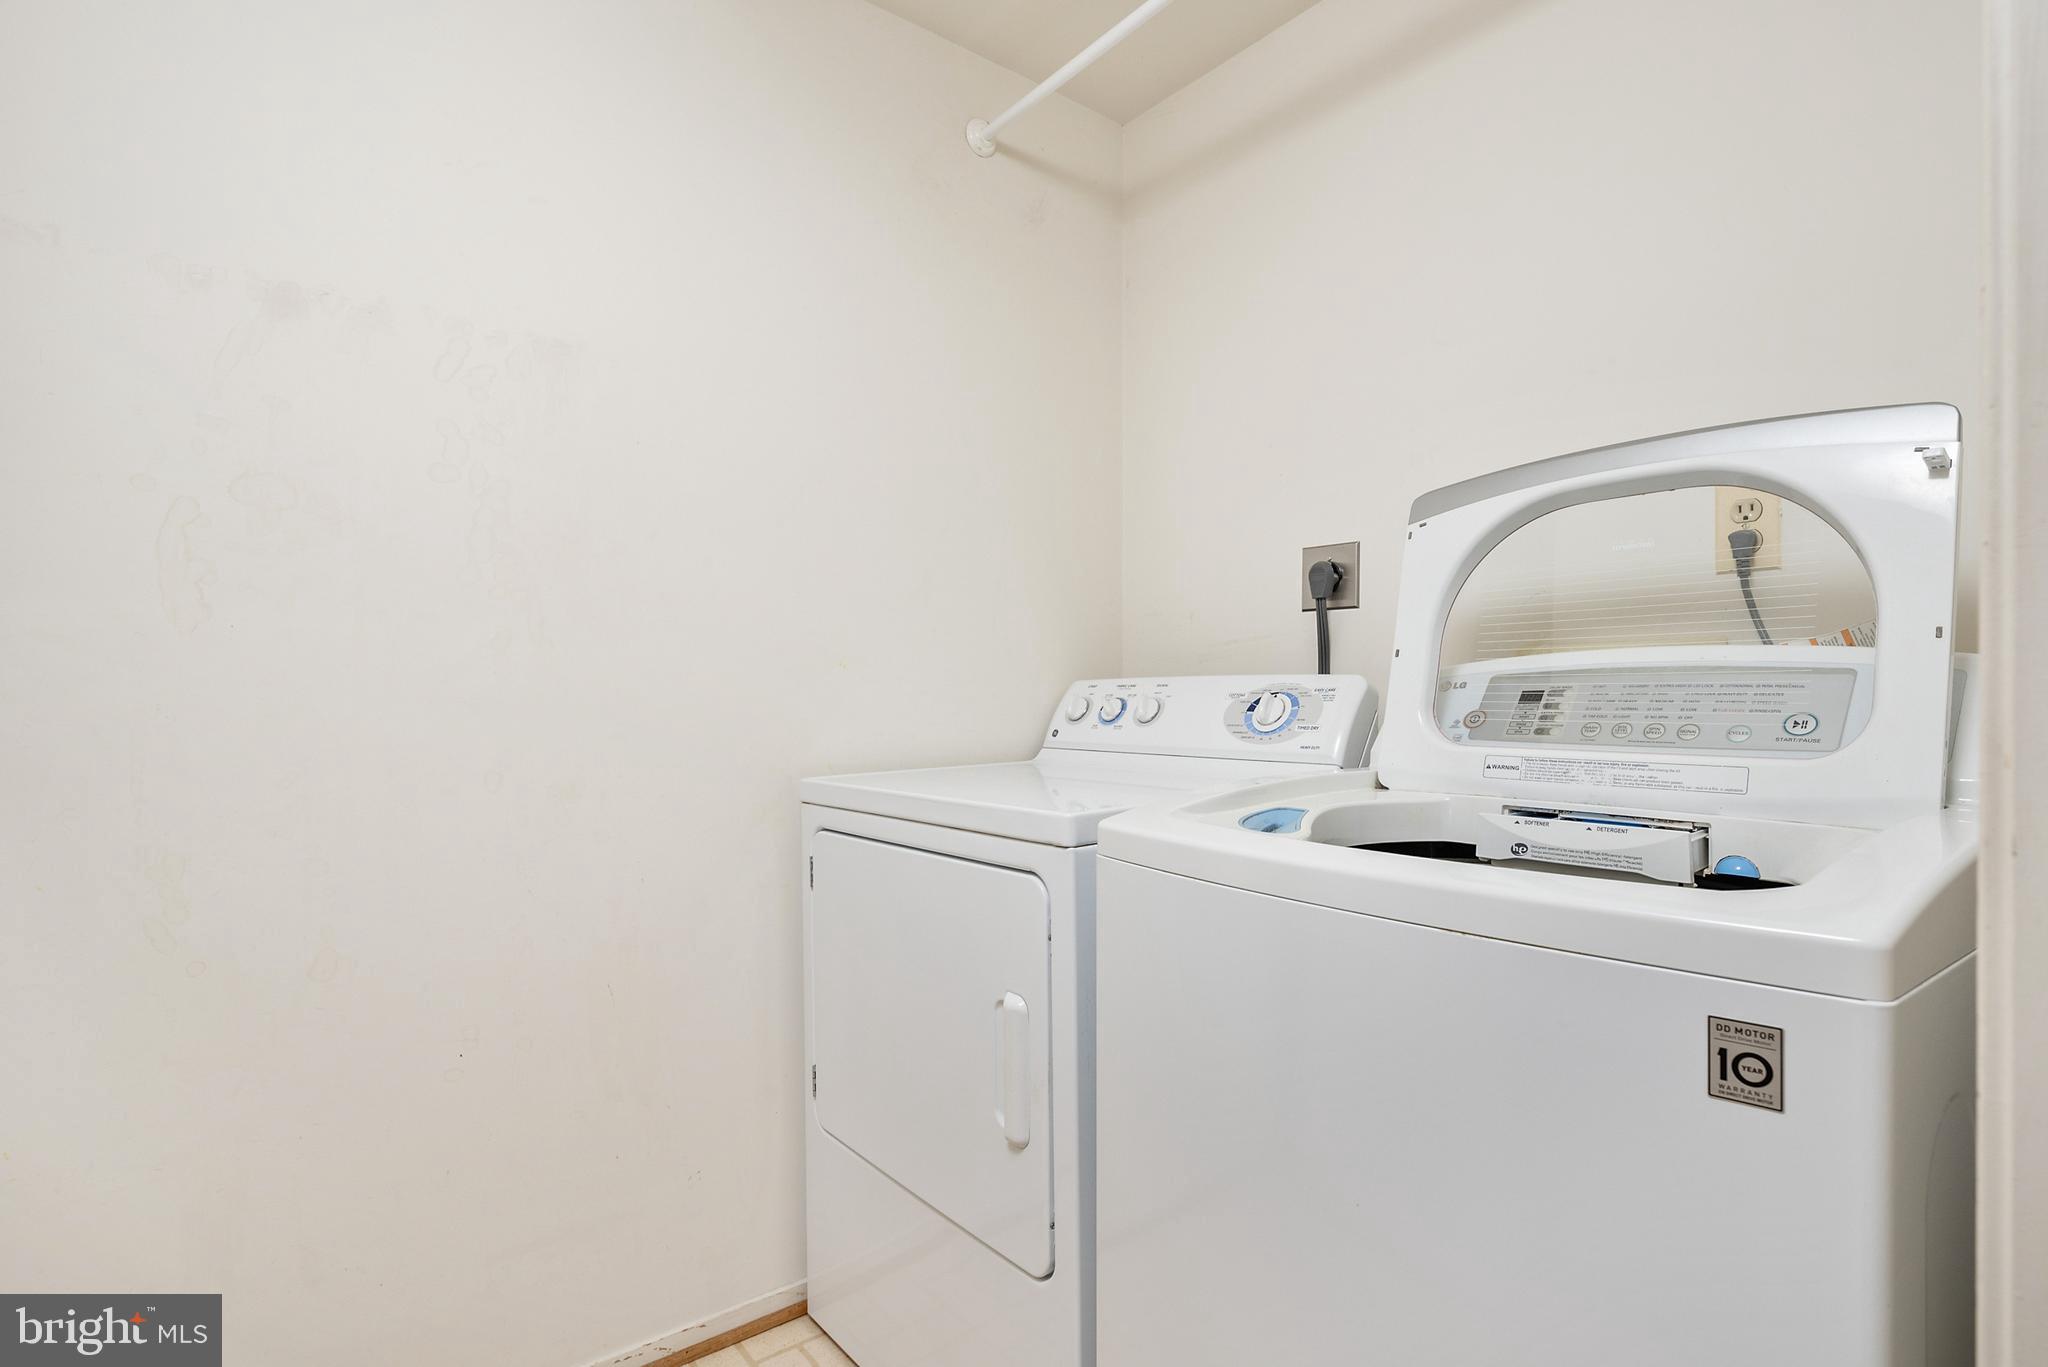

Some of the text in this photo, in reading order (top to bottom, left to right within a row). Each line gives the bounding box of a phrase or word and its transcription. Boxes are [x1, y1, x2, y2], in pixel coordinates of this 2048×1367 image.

[1452, 681, 1468, 690] LG
[1596, 826, 1628, 834] DETERGENT
[1716, 1023, 1775, 1042] DD MOTOR
[1717, 1047, 1774, 1088] 10
[1741, 1065, 1764, 1076] YEAR
[1718, 1083, 1773, 1100] WARRANTY
